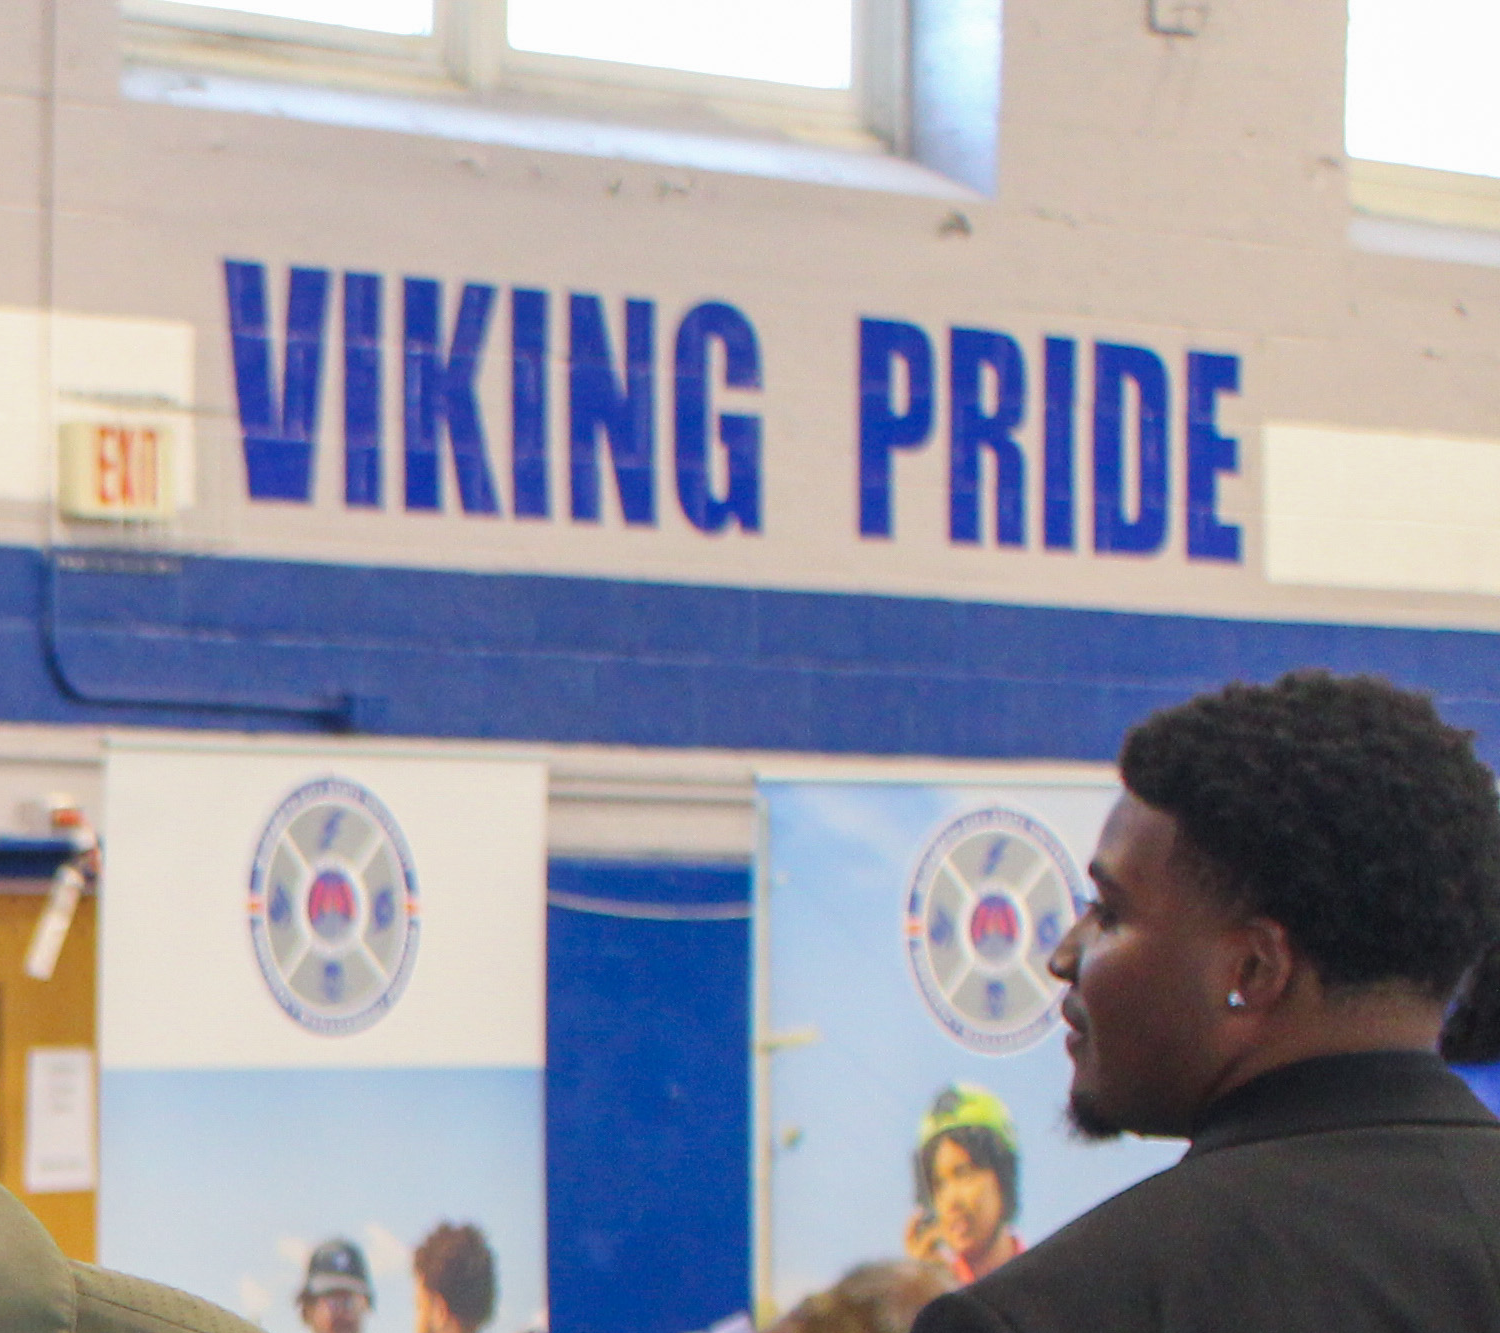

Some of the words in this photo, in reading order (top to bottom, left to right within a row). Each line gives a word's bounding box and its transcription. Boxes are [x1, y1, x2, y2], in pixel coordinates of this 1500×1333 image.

[95, 425, 159, 507] EXIT
[223, 258, 764, 534] VIKING
[857, 315, 1245, 563] PRIDE
